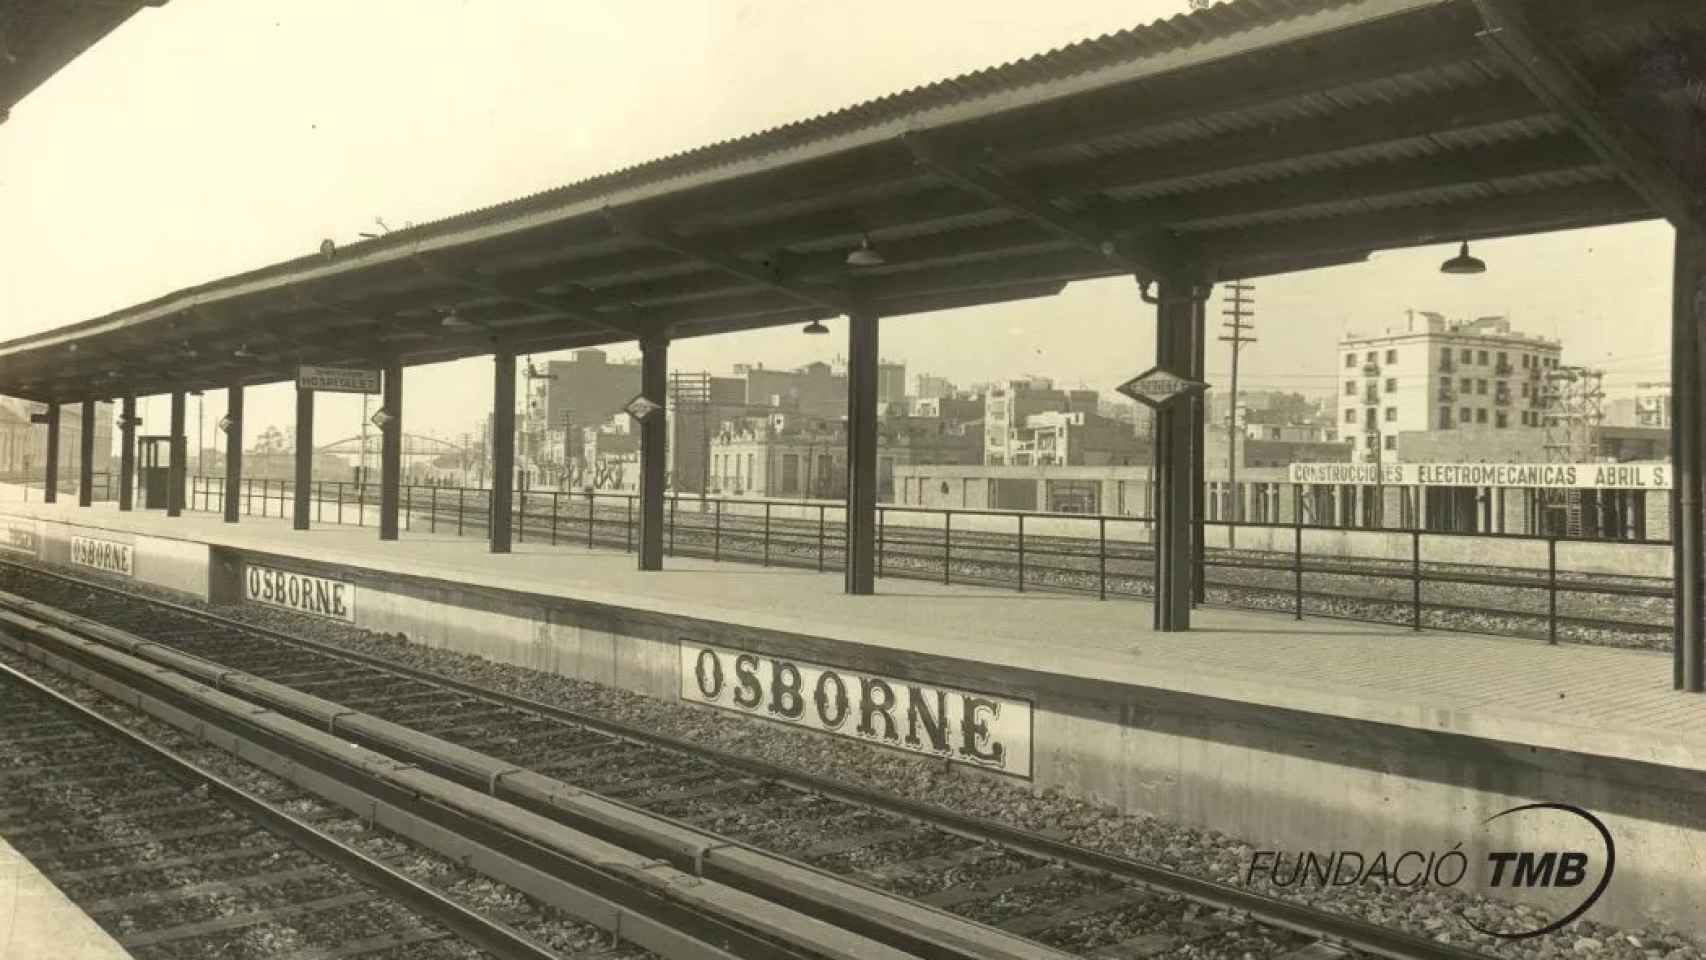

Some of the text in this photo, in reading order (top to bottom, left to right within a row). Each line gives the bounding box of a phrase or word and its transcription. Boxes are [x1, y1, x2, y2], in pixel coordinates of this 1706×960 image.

[1418, 465, 1577, 485] ELECTROMECANICAS
[1595, 467, 1645, 486] ABRIL
[72, 538, 129, 572] OSBORNE
[250, 566, 347, 617] OSBORNE
[695, 649, 1006, 768] OSBORNE
